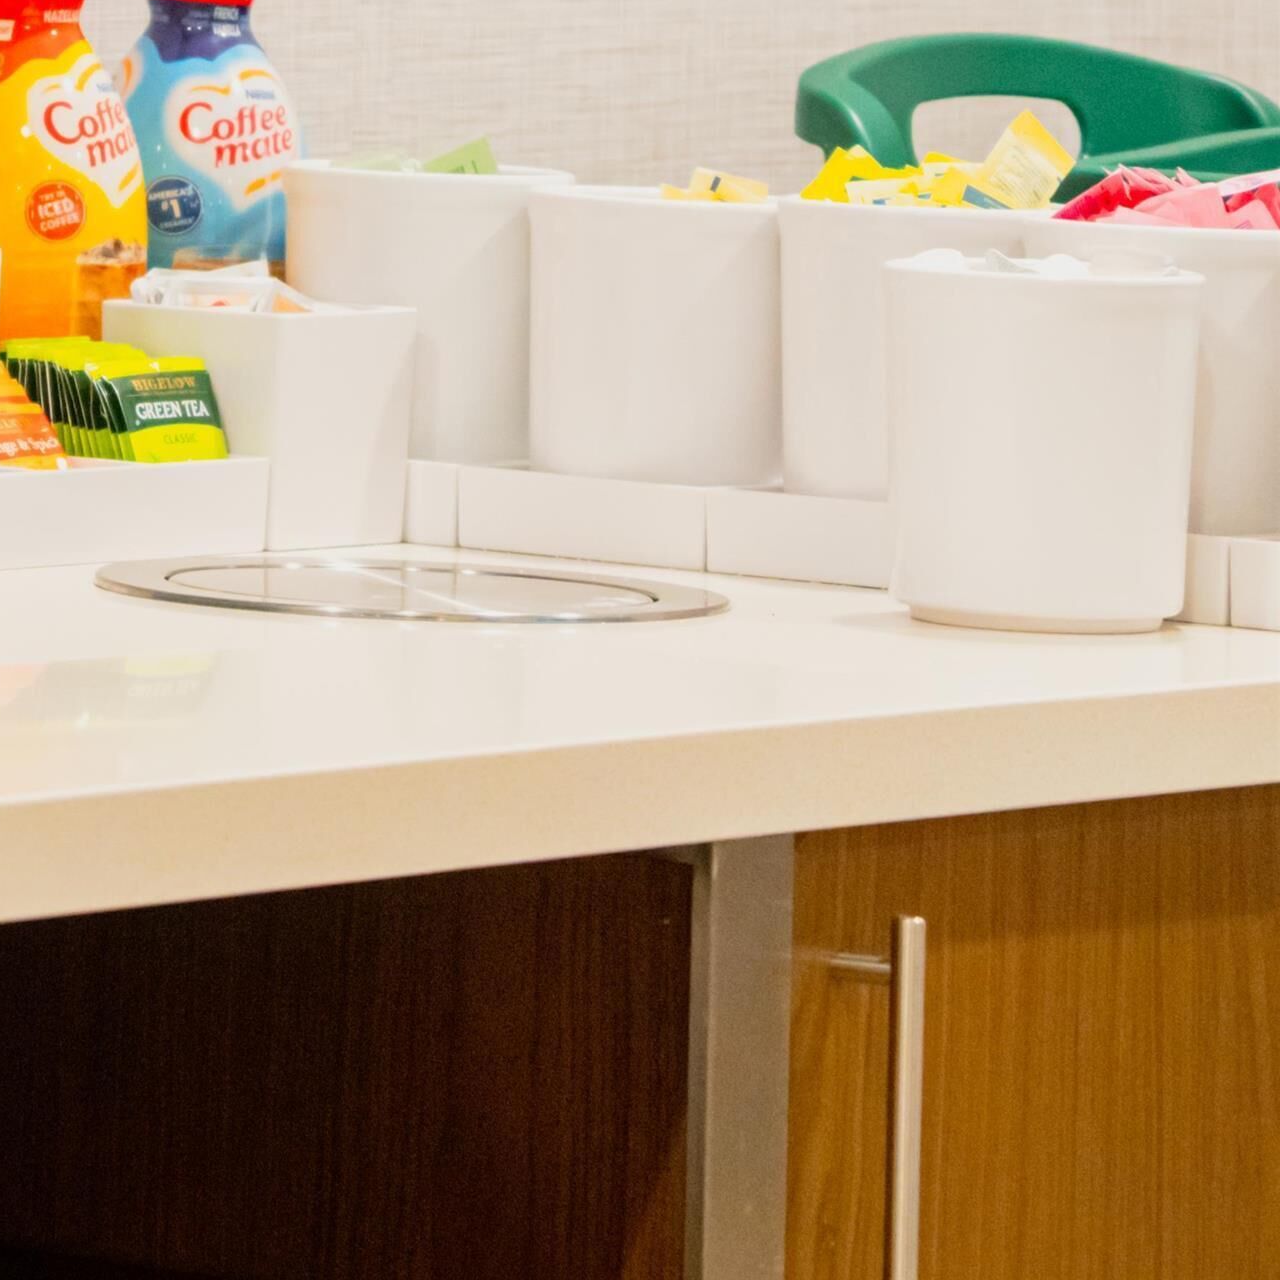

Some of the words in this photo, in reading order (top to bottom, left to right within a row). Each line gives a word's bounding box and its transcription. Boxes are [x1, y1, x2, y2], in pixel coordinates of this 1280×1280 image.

[43, 97, 125, 145] Coffe
[179, 102, 287, 145] Coffee
[213, 128, 293, 168] mate
[37, 197, 75, 219] ICED
[135, 400, 182, 420] GREEN
[181, 399, 210, 418] TEA
